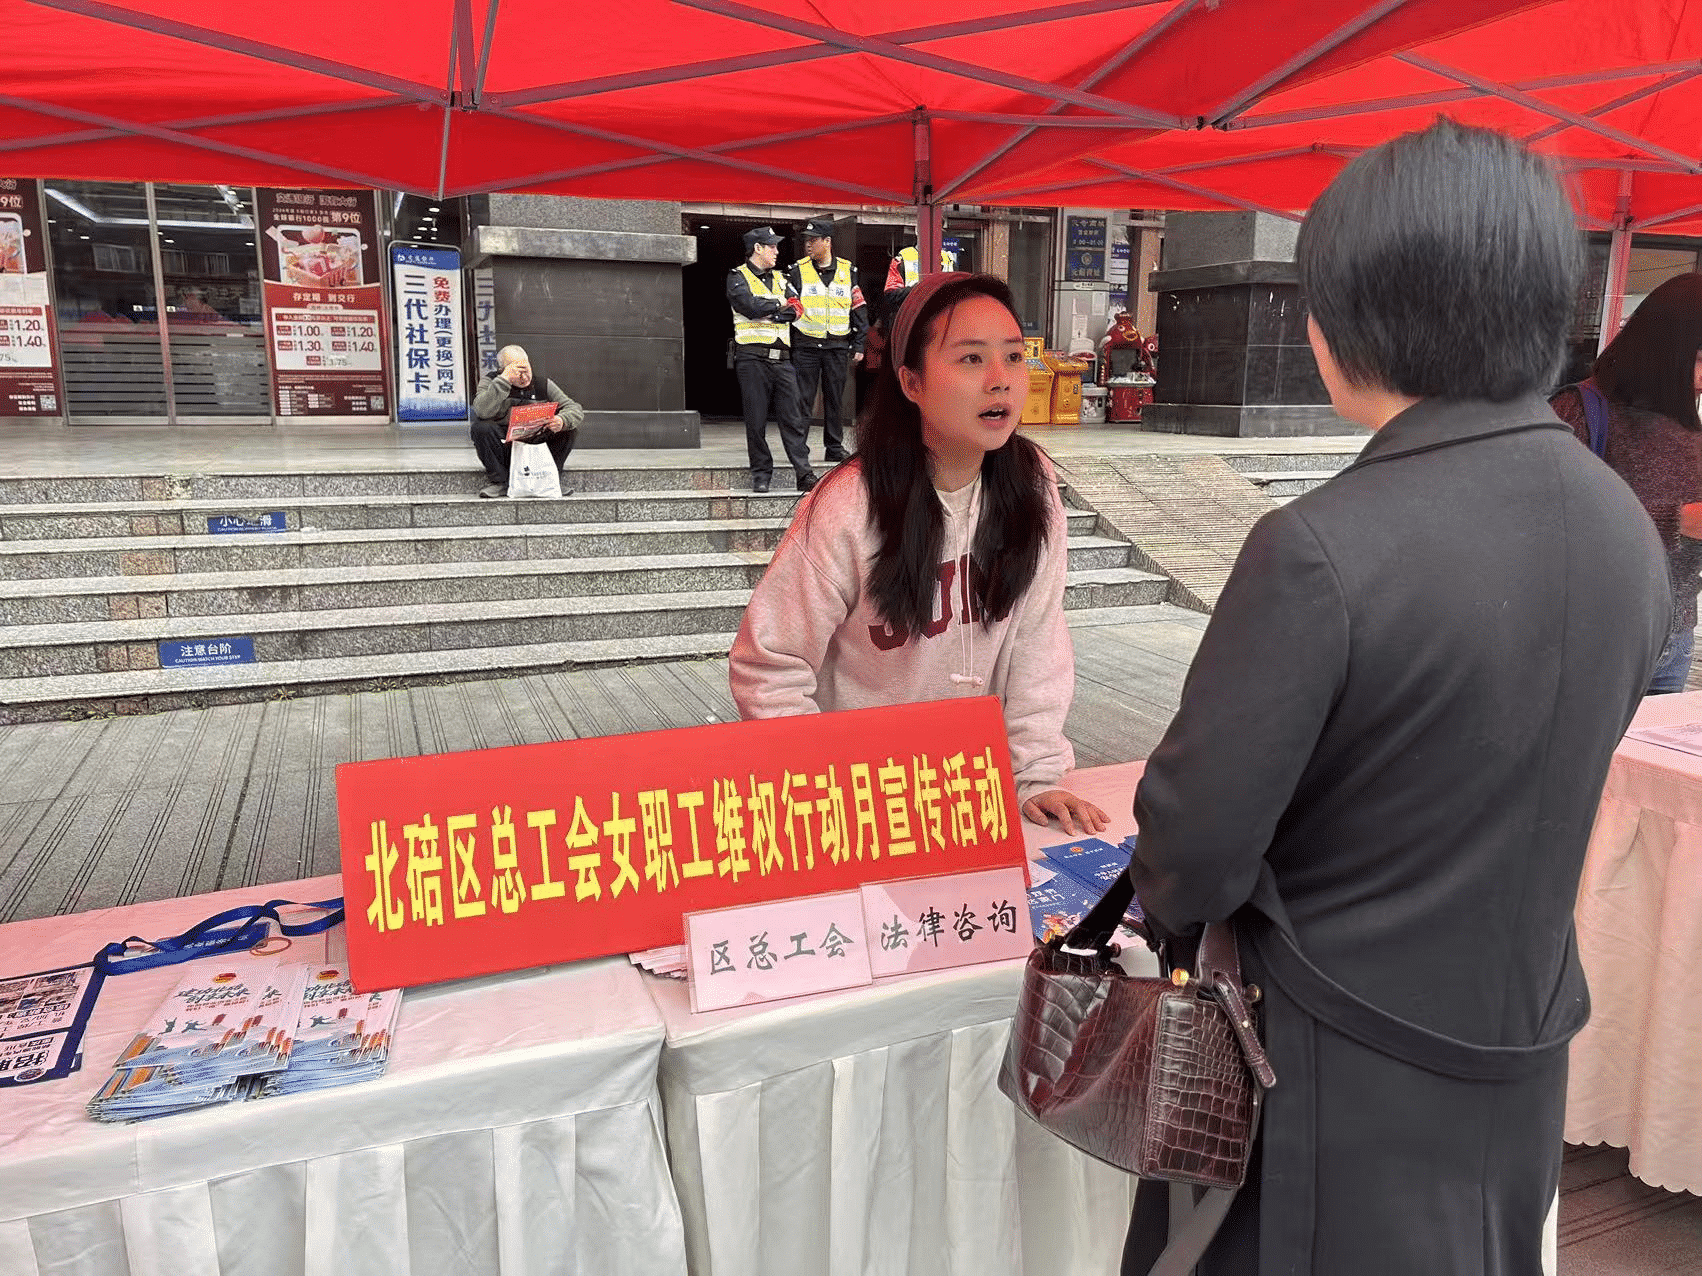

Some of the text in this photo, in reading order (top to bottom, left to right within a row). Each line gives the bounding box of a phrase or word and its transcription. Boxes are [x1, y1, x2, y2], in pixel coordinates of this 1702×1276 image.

[403, 274, 431, 394] 三代社保卡
[220, 514, 272, 527] 小心滑
[180, 642, 232, 657] 注意台阶
[365, 747, 1007, 932] 北碚区总工会女职工维权行动月宣传活动
[710, 922, 855, 976] 区总工会
[880, 899, 1017, 952] 法律咨询
